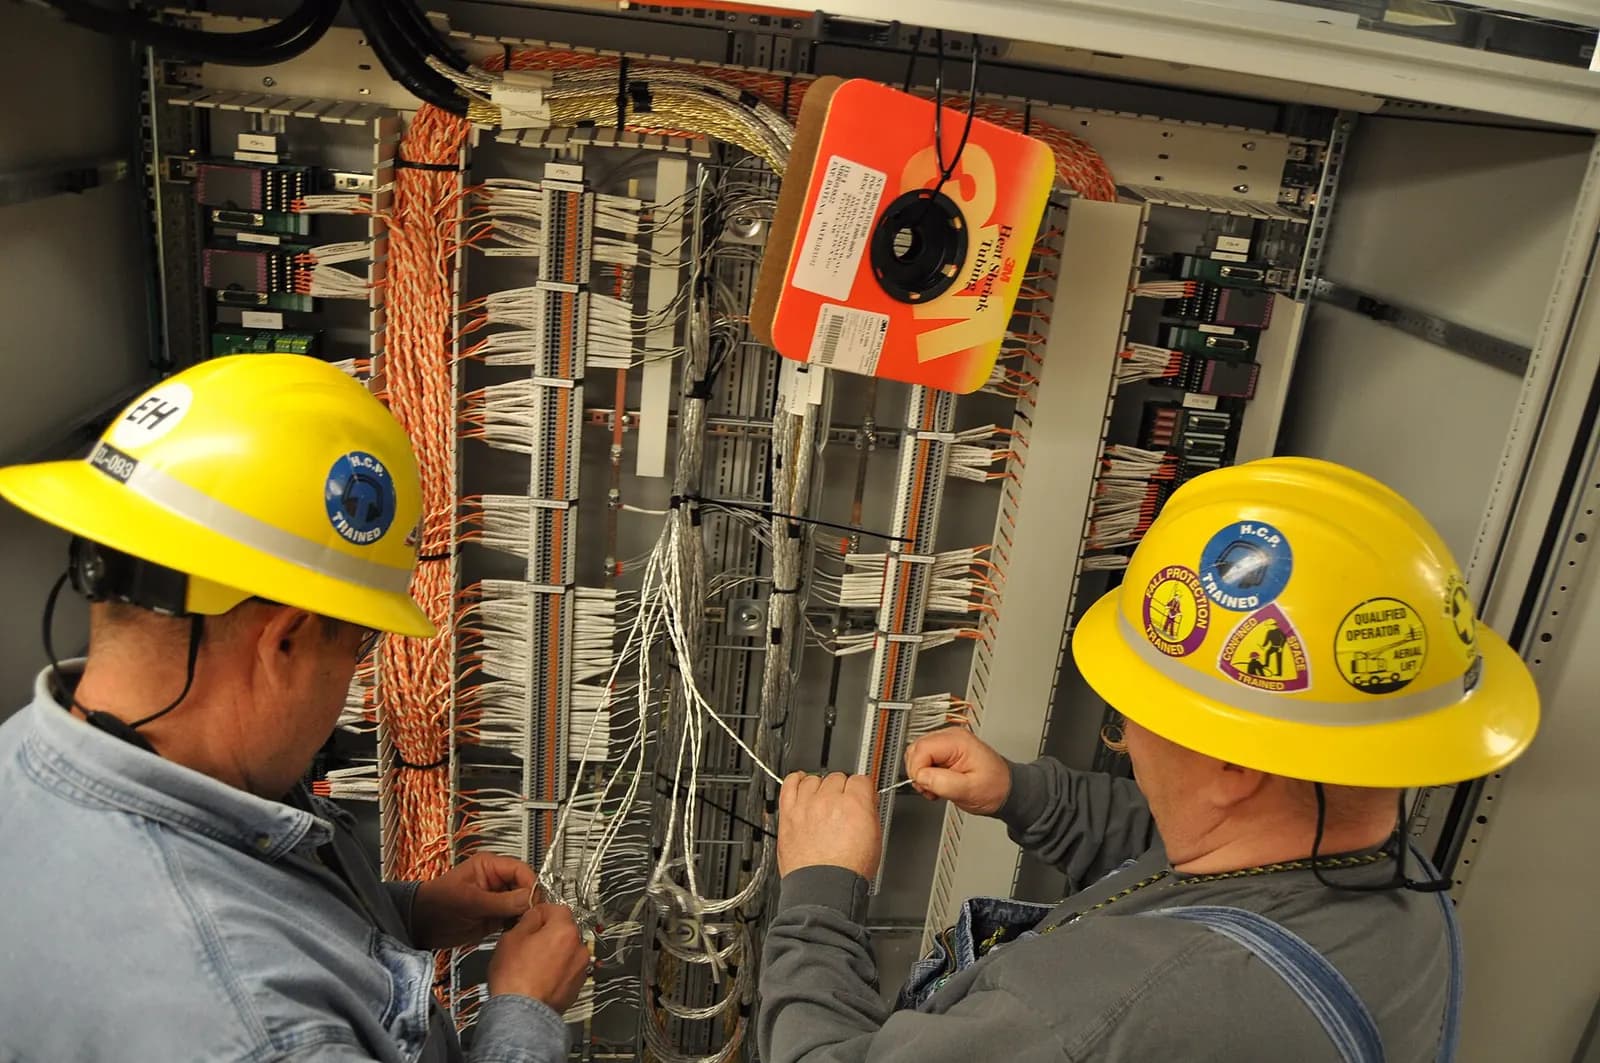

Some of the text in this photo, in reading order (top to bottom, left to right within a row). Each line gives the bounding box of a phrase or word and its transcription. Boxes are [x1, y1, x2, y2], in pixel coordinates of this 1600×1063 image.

[965, 239, 993, 291] Tubing
[976, 224, 1012, 312] Heat Shrink
[1000, 257, 1016, 283] 3M
[880, 319, 888, 332] 3M
[125, 396, 179, 430] EH
[350, 456, 384, 477] H.C.P.
[332, 511, 382, 542] TRAINED
[1240, 524, 1281, 548] H.C.P.
[1146, 568, 1209, 629] FALL PROTECTION
[1202, 572, 1259, 609] TRAINED
[1354, 607, 1406, 625] QUALIFIED
[1146, 623, 1185, 656] TRAINED
[1222, 617, 1307, 671] CONFINED SPACE
[1346, 624, 1400, 641] OPERATOR
[1393, 646, 1422, 659] AERIAL
[1400, 660, 1416, 672] LIFT
[1238, 672, 1285, 690] TRAINED
